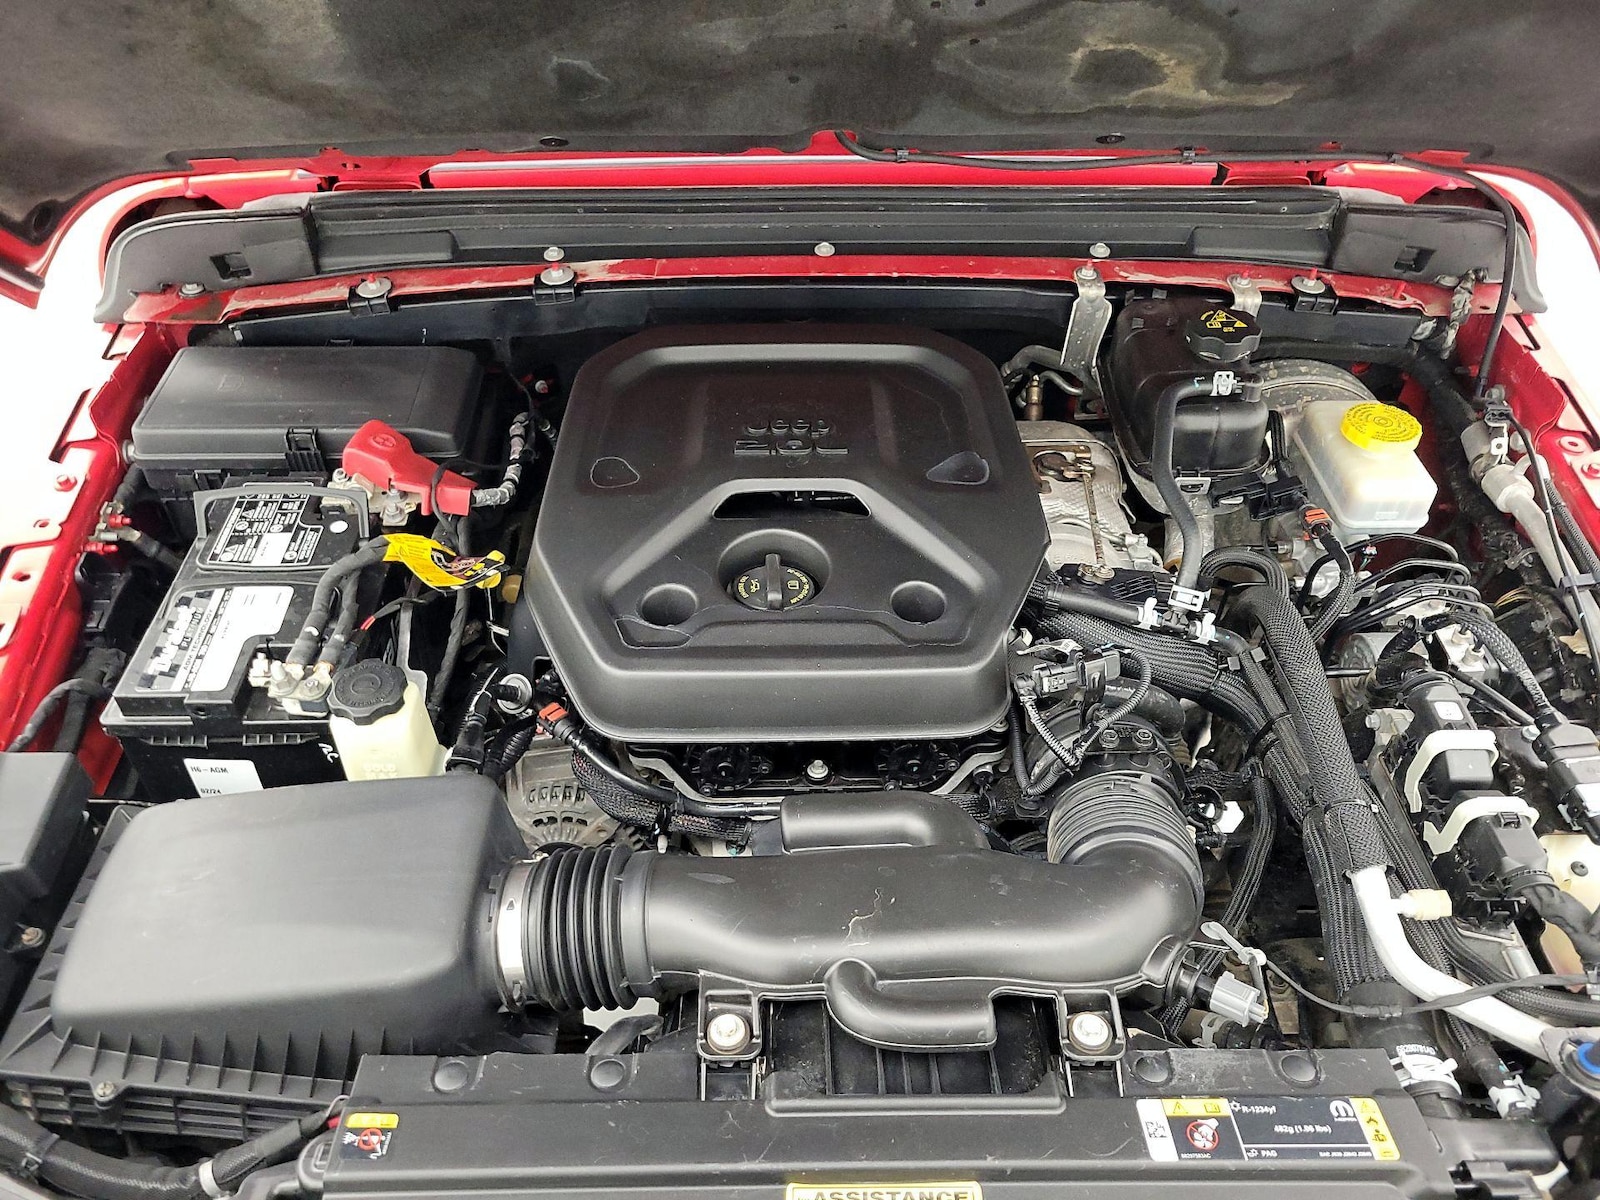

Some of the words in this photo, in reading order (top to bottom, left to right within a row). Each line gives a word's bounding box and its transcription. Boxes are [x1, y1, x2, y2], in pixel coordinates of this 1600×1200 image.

[743, 418, 831, 438] Jeep
[146, 604, 197, 675] Duralast
[191, 608, 214, 653] TECHNOLOGY
